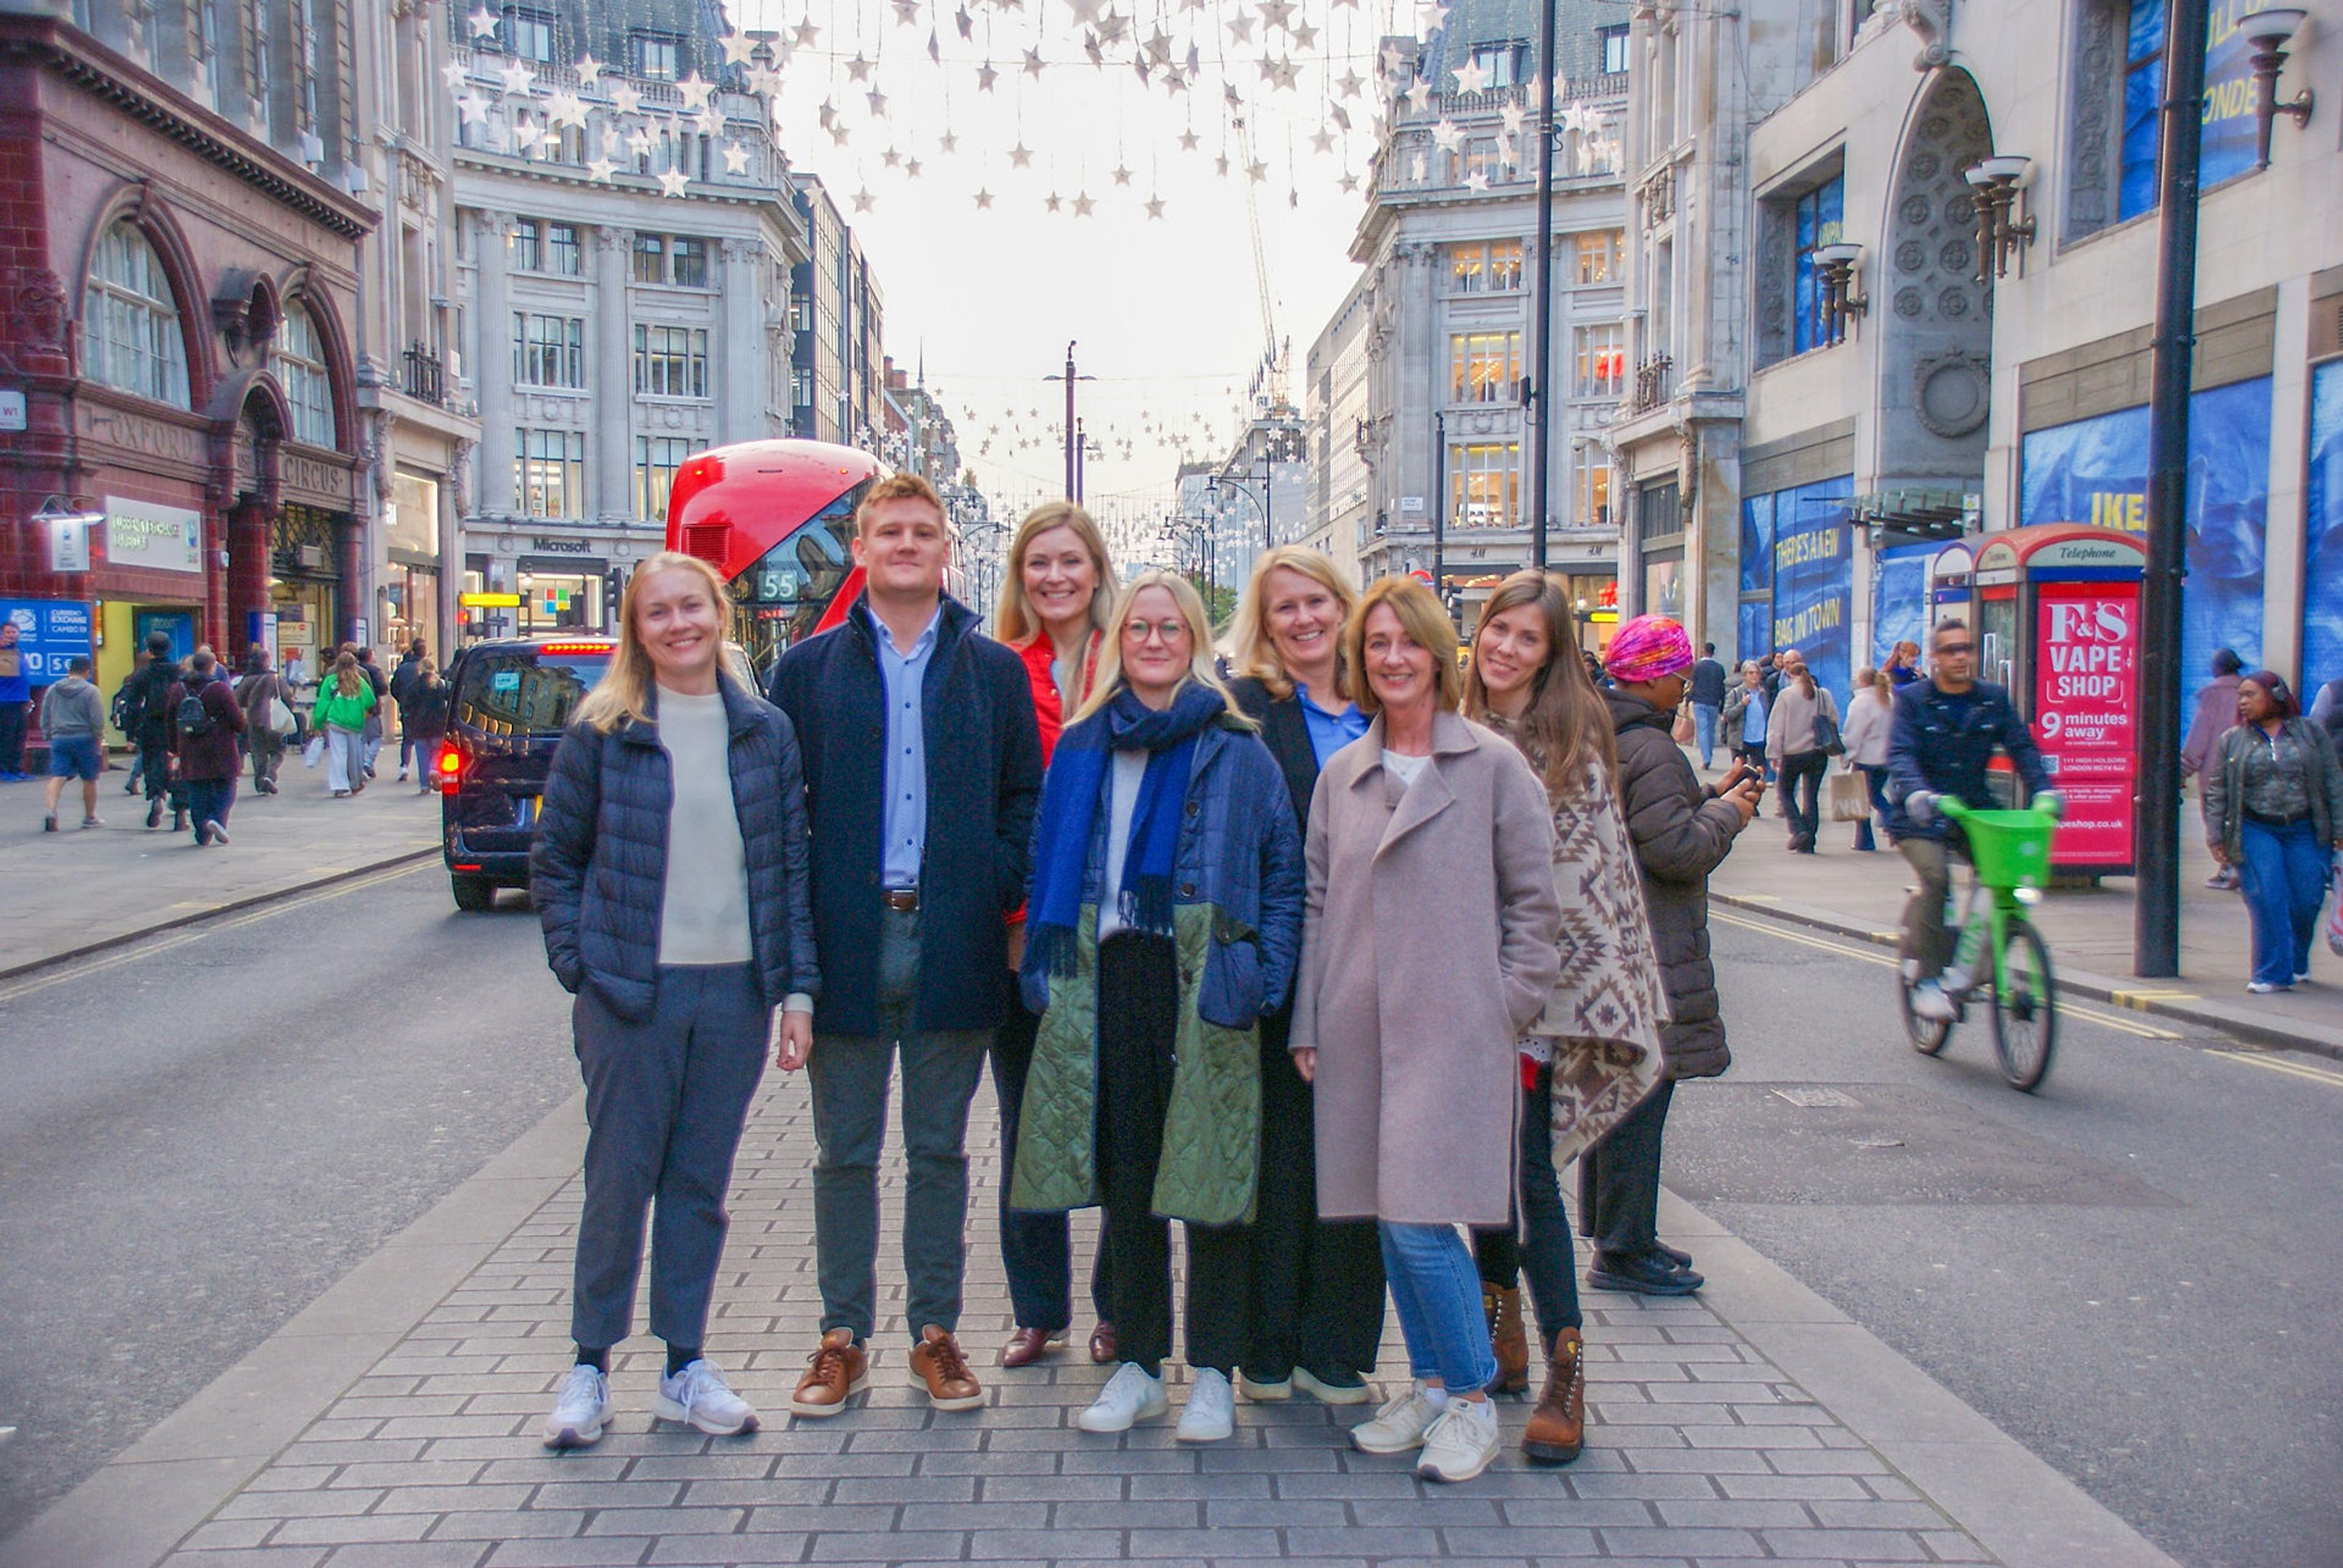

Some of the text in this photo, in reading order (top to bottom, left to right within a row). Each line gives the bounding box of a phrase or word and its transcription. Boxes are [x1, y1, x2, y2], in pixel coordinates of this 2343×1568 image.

[3, 407, 18, 417] W1
[110, 413, 194, 461] OXFORD
[285, 455, 338, 494] CIRCUS
[2092, 493, 2147, 532] IKE
[534, 537, 591, 552] Microsoft
[1817, 528, 1839, 559] NEW
[2059, 547, 2116, 560] Telephone
[764, 574, 793, 597] 55
[1775, 617, 1793, 647] BAG
[1808, 597, 1840, 634] TOWN
[2045, 601, 2127, 643] F&S
[2049, 645, 2122, 672] VAPE
[2058, 675, 2116, 697] SHOP
[2042, 711, 2127, 739] 9 minutes
[2065, 727, 2104, 740] away
